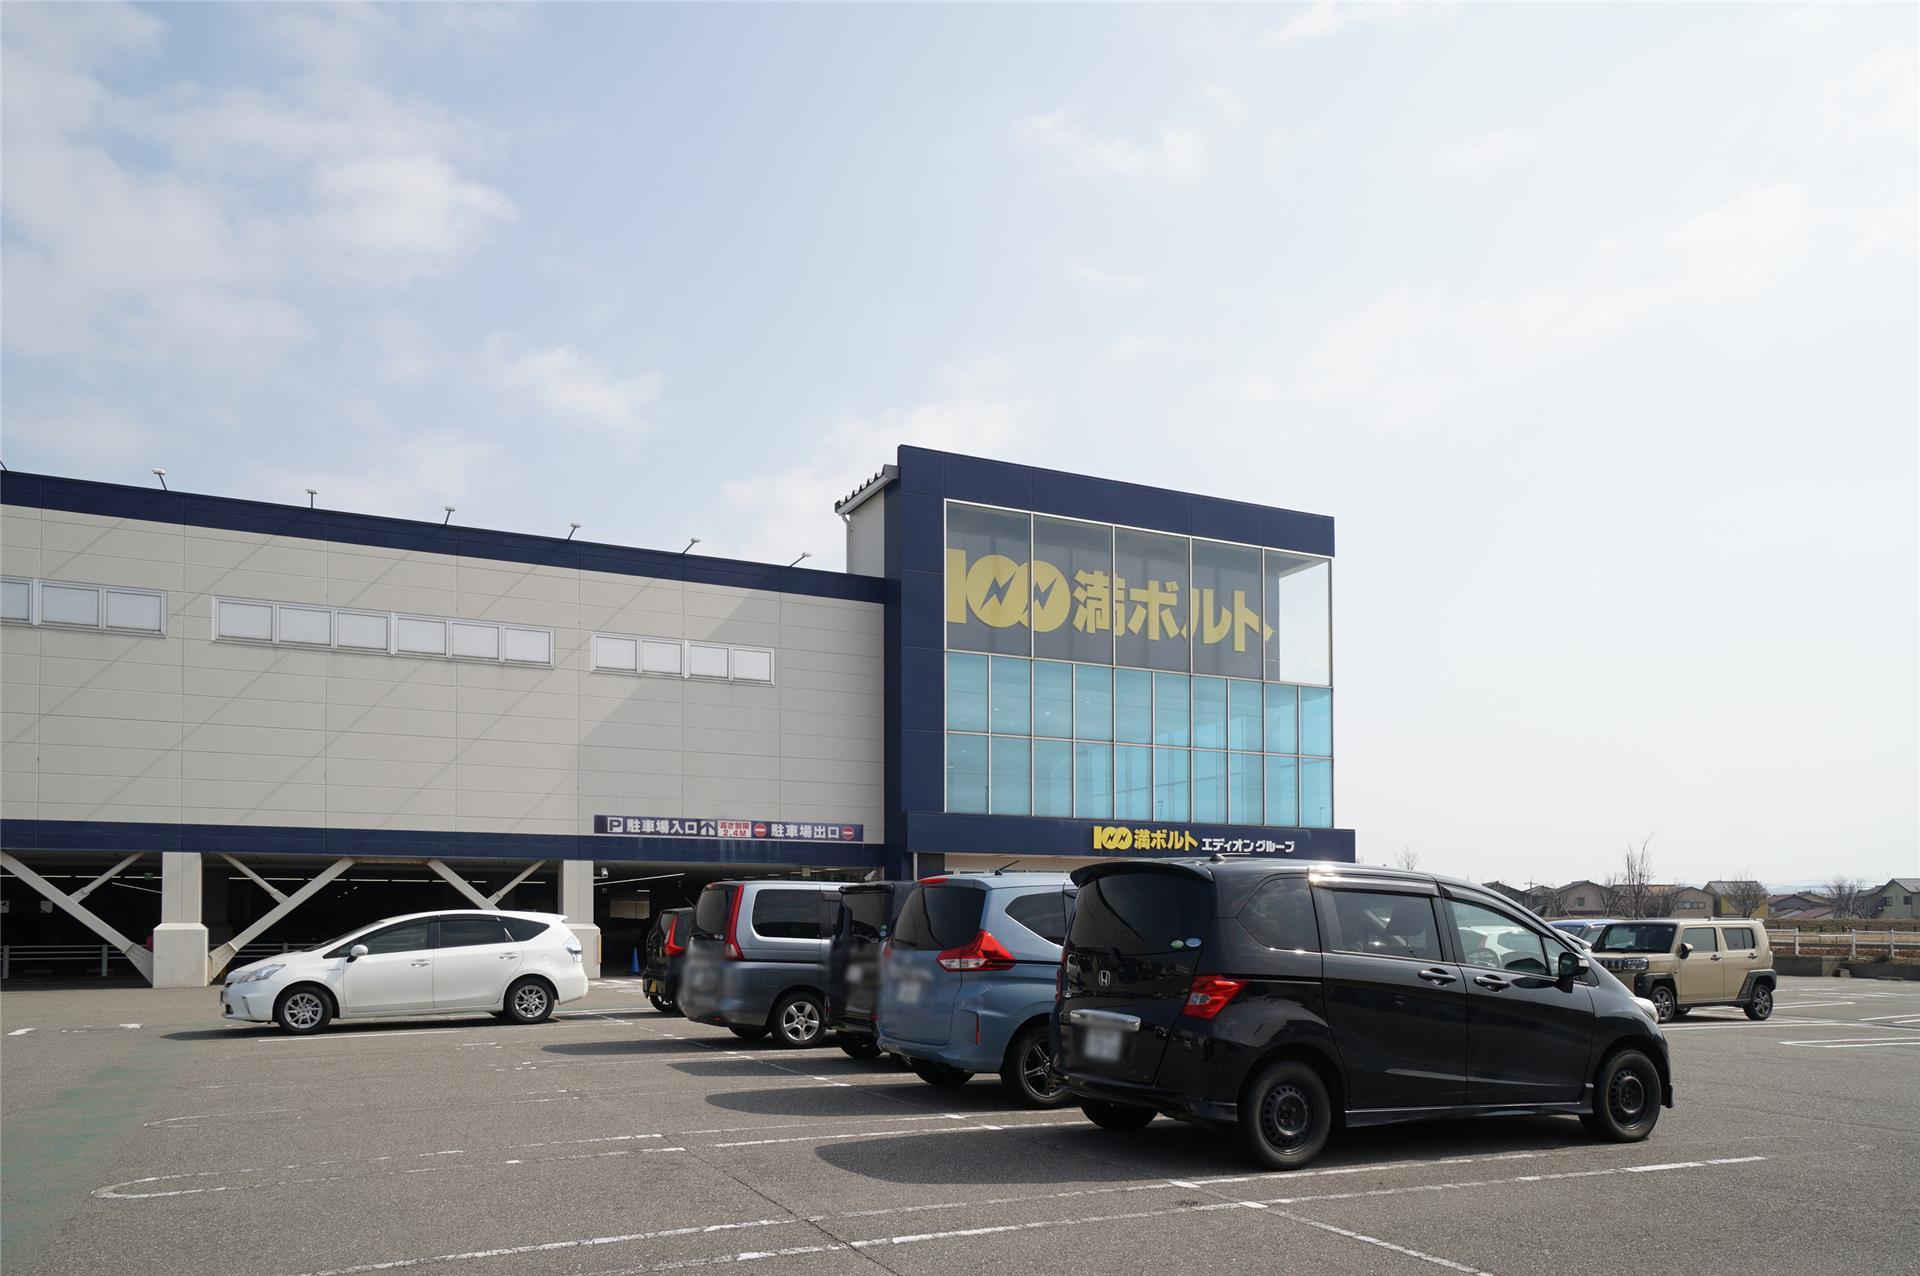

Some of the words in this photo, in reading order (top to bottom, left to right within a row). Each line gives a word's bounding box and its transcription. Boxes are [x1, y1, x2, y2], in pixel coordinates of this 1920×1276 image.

[626, 818, 698, 835] 駐車場入口
[771, 824, 840, 839] 駐車場出口
